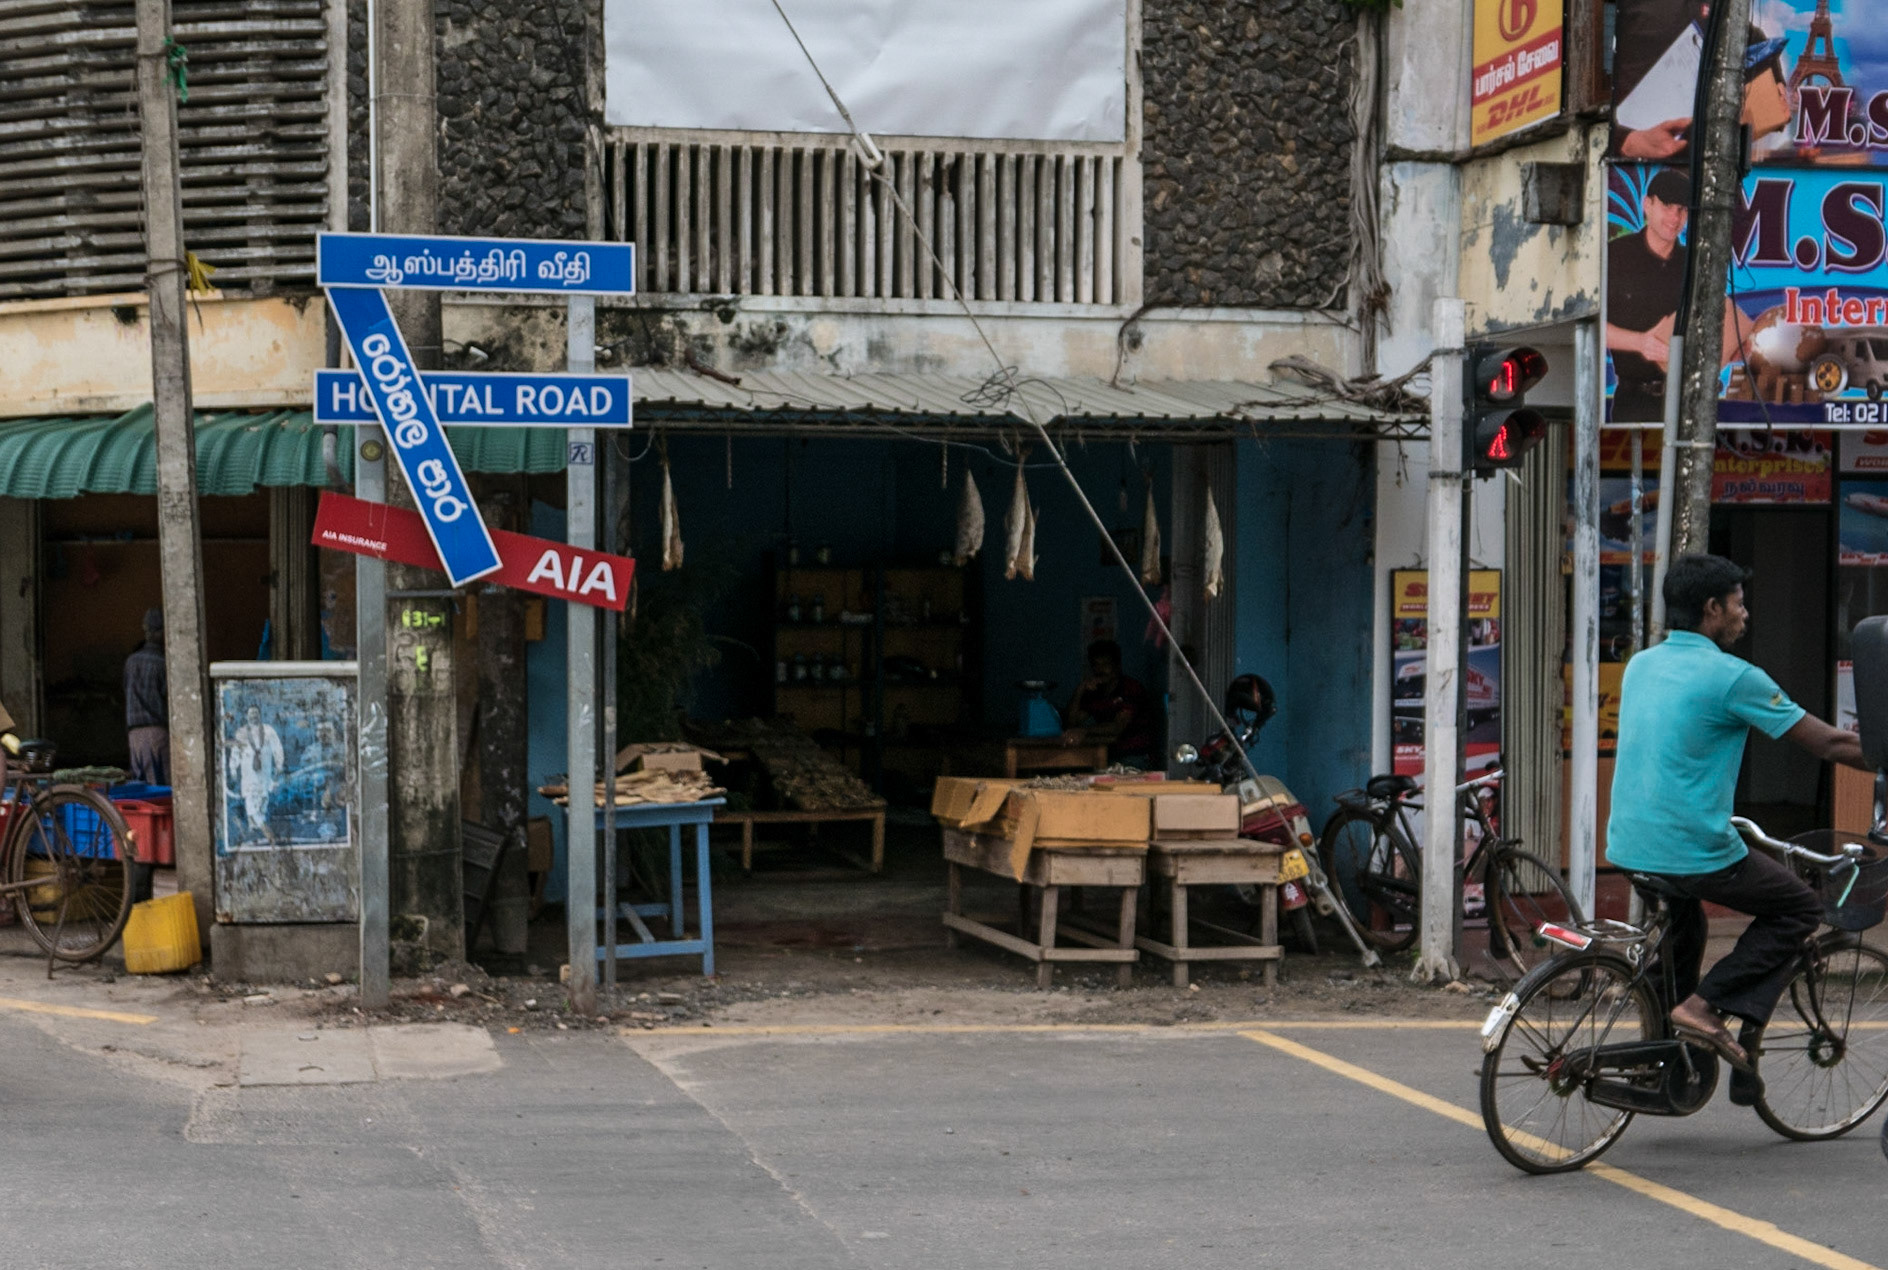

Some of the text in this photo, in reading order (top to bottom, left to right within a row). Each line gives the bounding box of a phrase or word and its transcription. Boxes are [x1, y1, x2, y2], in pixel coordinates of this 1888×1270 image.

[1487, 85, 1541, 130] DHL
[365, 248, 591, 286] ஆஸ்பத்திரி வீதி
[1785, 287, 1888, 325] Inter
[516, 385, 613, 416] ROAD
[1825, 402, 1851, 423] Tel:
[361, 333, 468, 522] රෝහල පාර
[1714, 456, 1826, 478] nterprises
[322, 529, 388, 551] AIA INSURANCE
[527, 549, 617, 603] AIA
